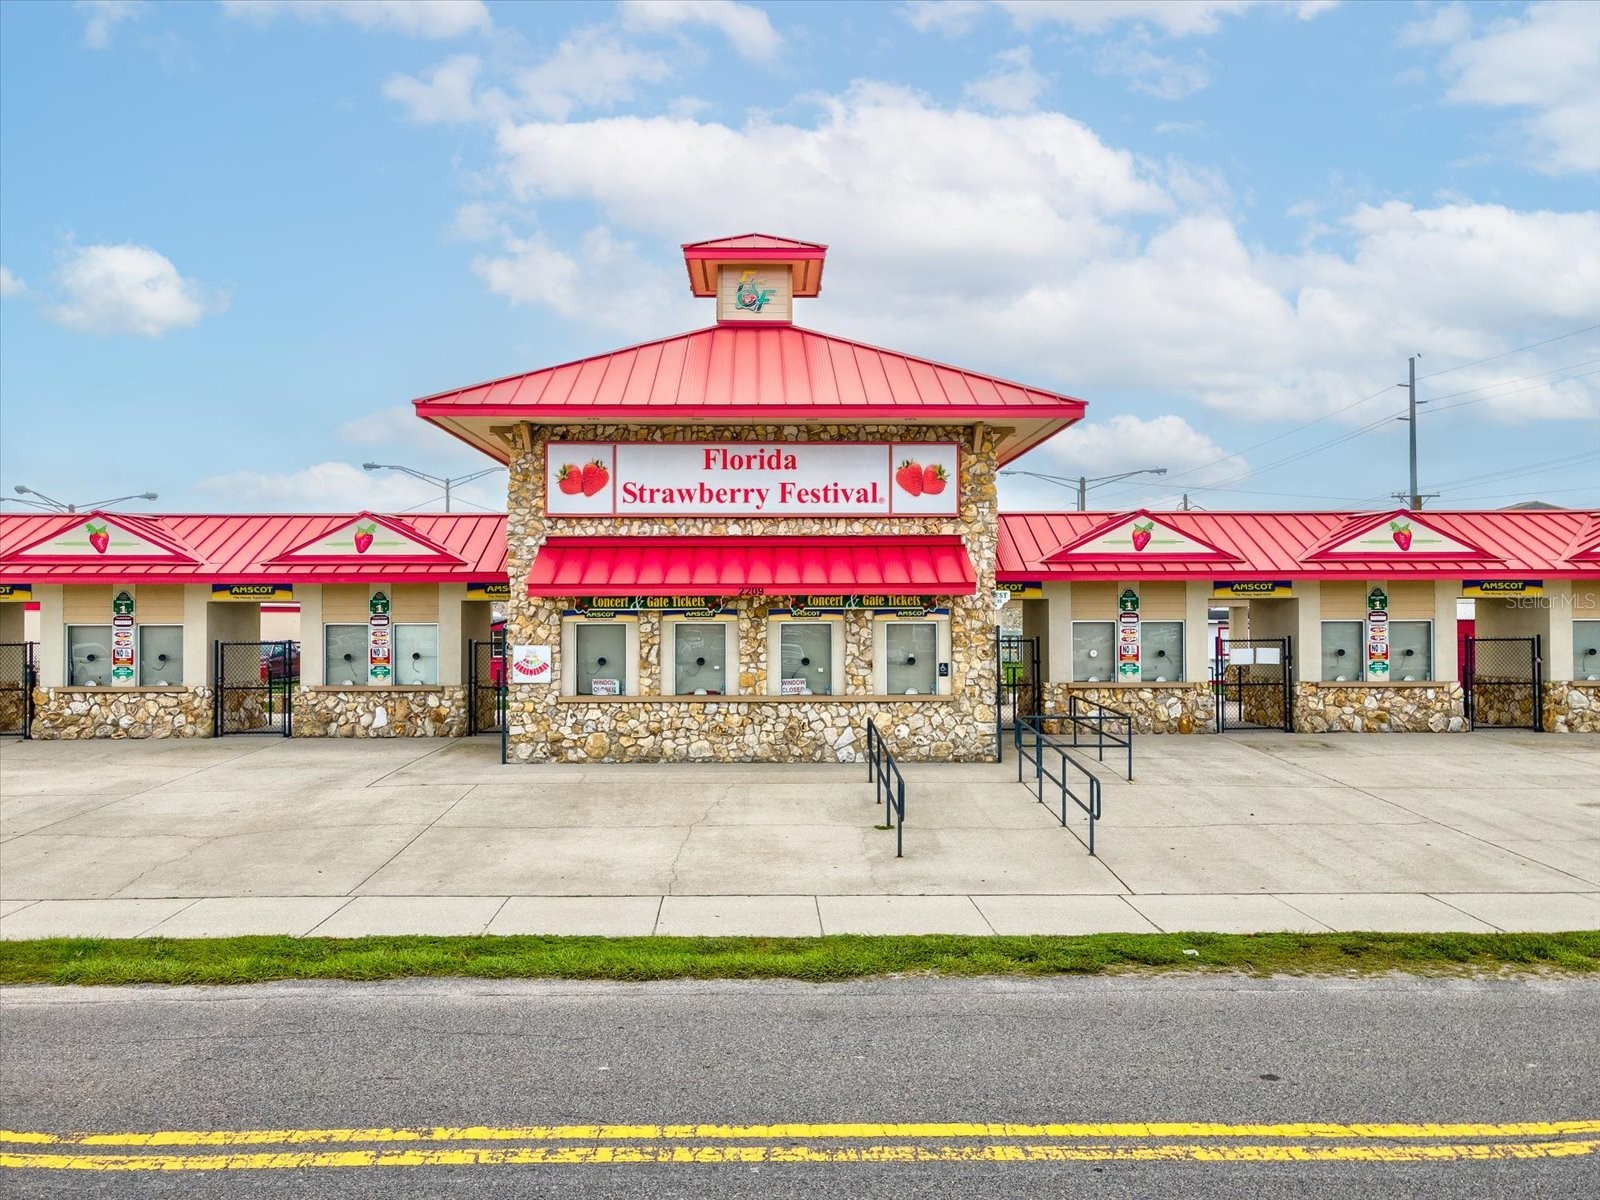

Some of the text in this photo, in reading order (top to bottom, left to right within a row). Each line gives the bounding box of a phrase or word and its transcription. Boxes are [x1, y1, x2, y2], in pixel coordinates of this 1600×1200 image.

[702, 448, 798, 471] Florida
[621, 481, 770, 510] Strawberry
[738, 587, 764, 596] 2209
[997, 583, 1023, 591] SCOT
[592, 596, 629, 608] Concert
[646, 596, 669, 608] Gate
[671, 596, 706, 608] Tickets
[807, 595, 844, 606] Concert
[862, 595, 885, 606] Gate
[887, 595, 921, 606] Tickets
